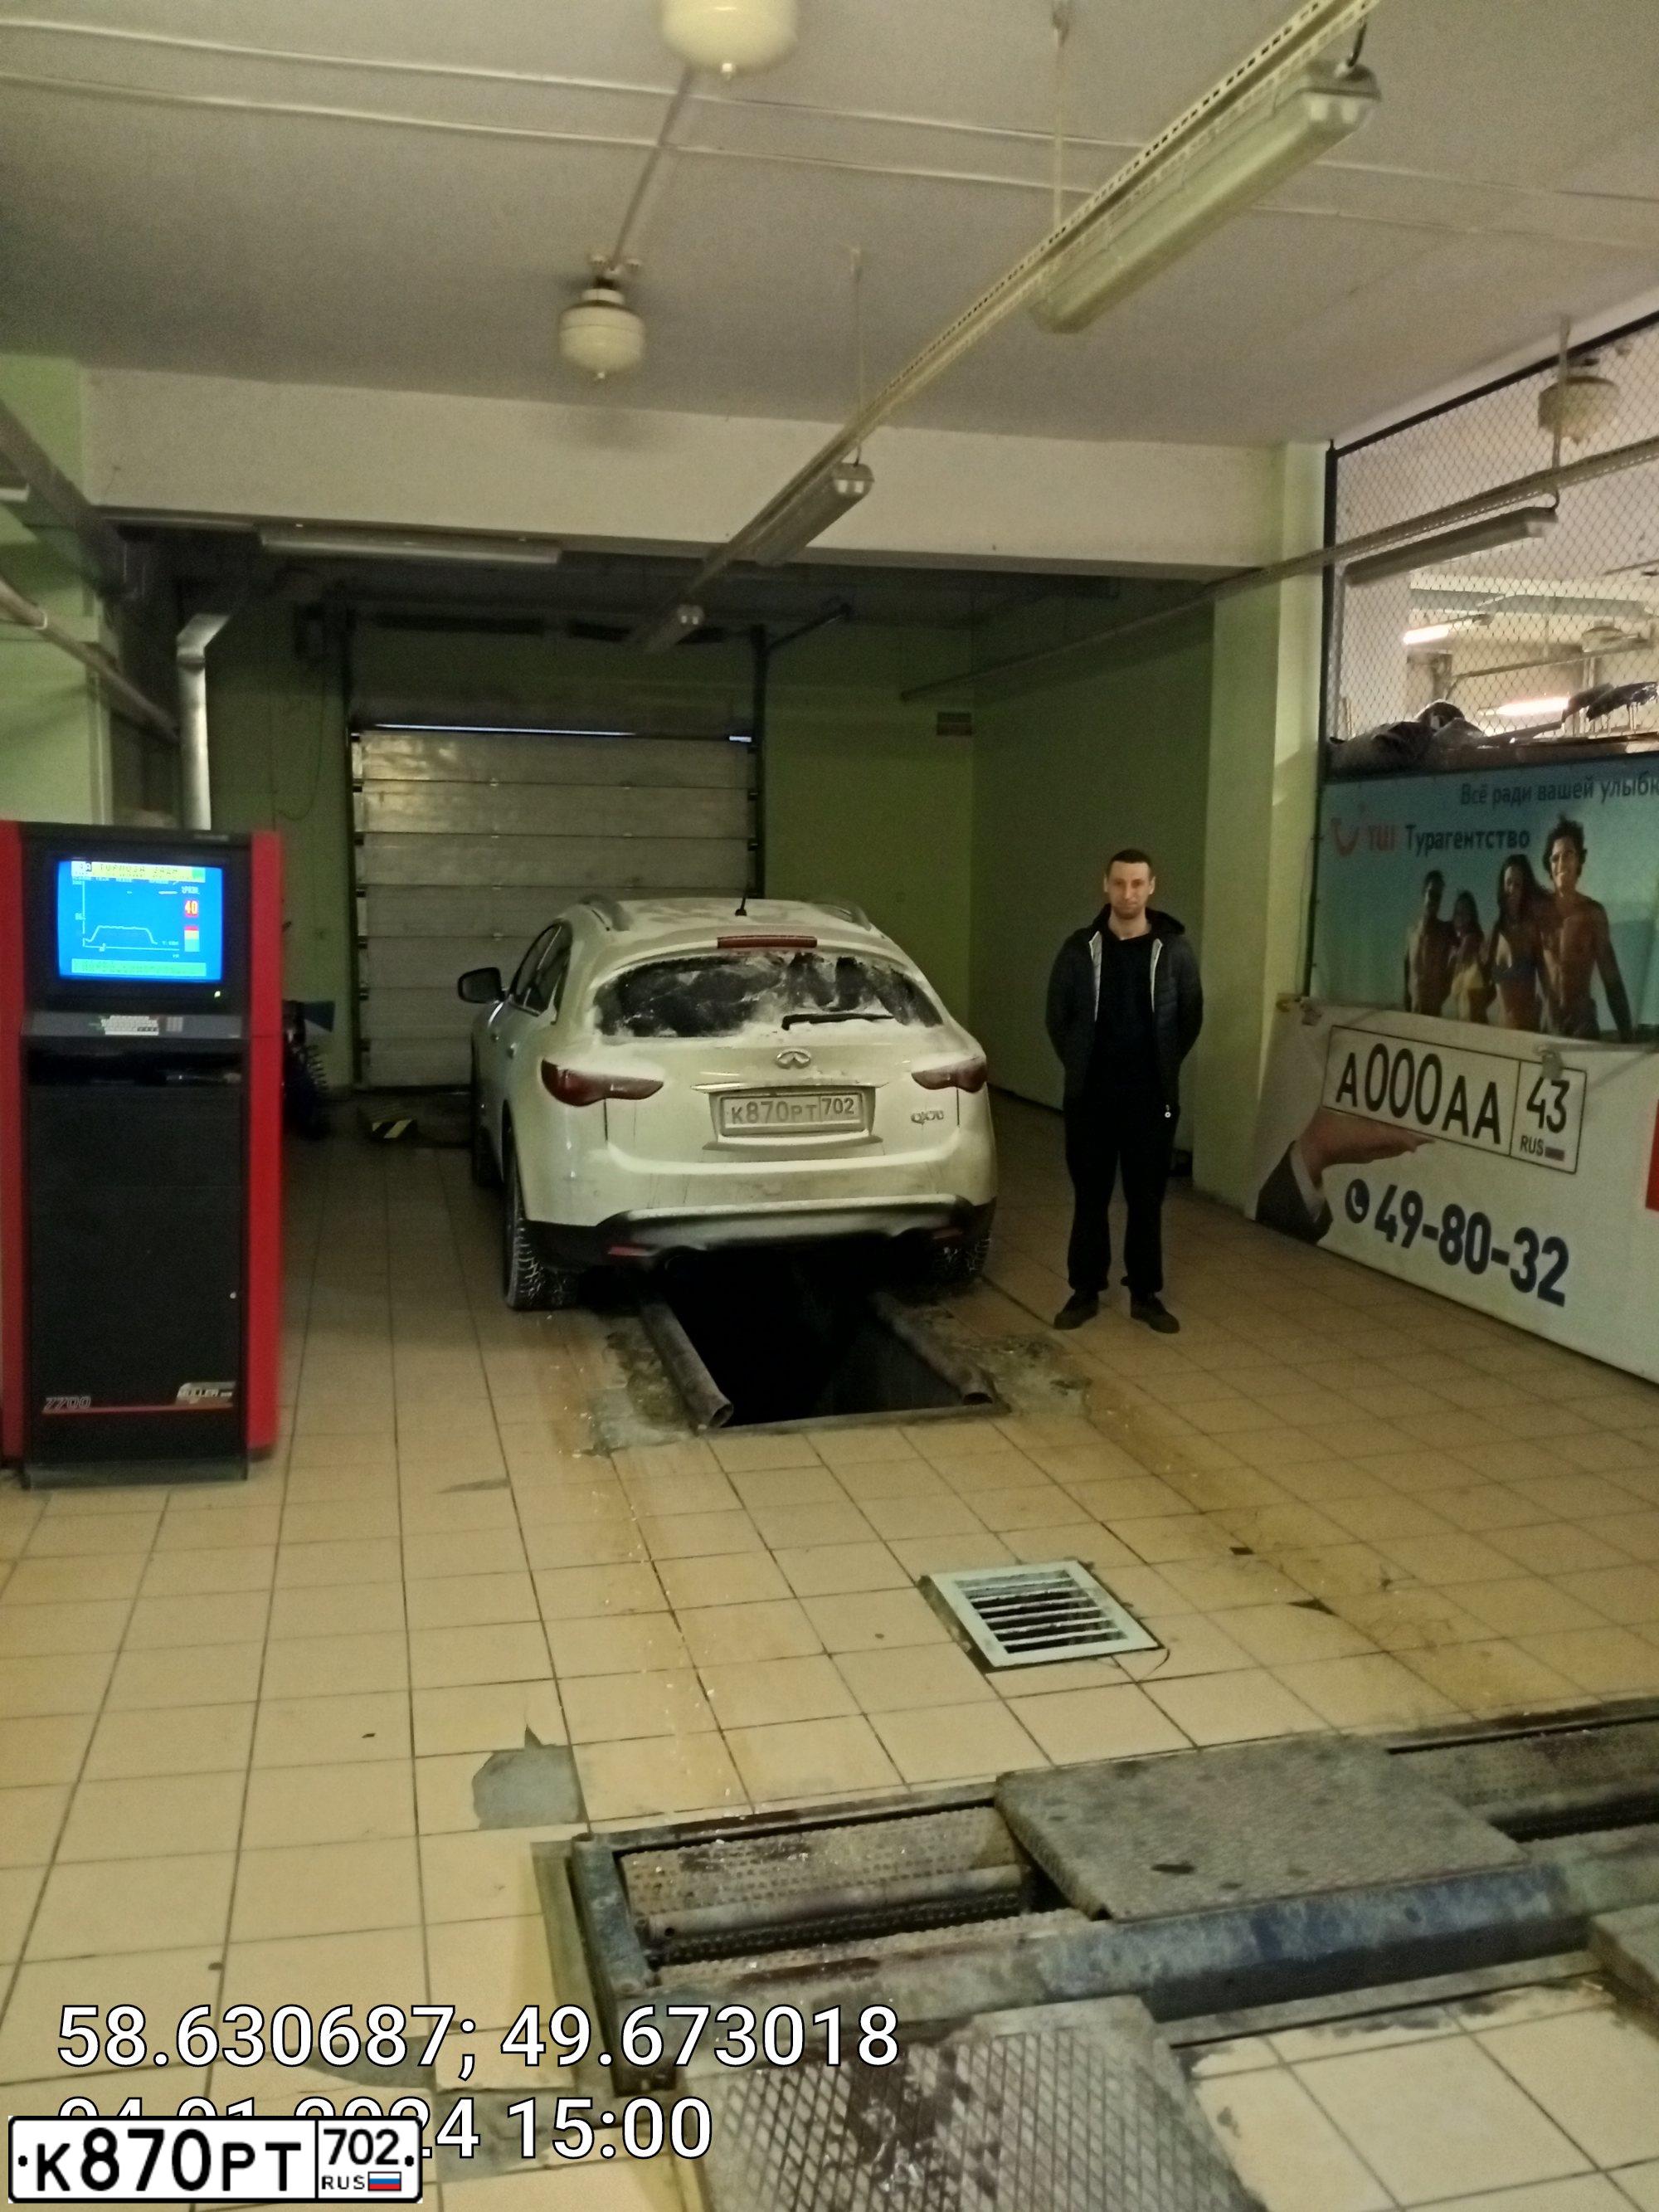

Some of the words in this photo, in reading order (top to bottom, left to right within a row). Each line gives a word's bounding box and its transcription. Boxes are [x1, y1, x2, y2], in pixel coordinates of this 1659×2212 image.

[1461, 782, 1487, 805] Всё
[1493, 785, 1532, 807] ради
[1537, 775, 1594, 801] вашей
[1404, 824, 1531, 857] Турагентство
[731, 1100, 818, 1125] К870РТ
[821, 1098, 855, 1115] 702
[1526, 1076, 1570, 1133] 43
[1520, 1135, 1544, 1157] RUS
[1374, 1184, 1569, 1308] 49-80-32
